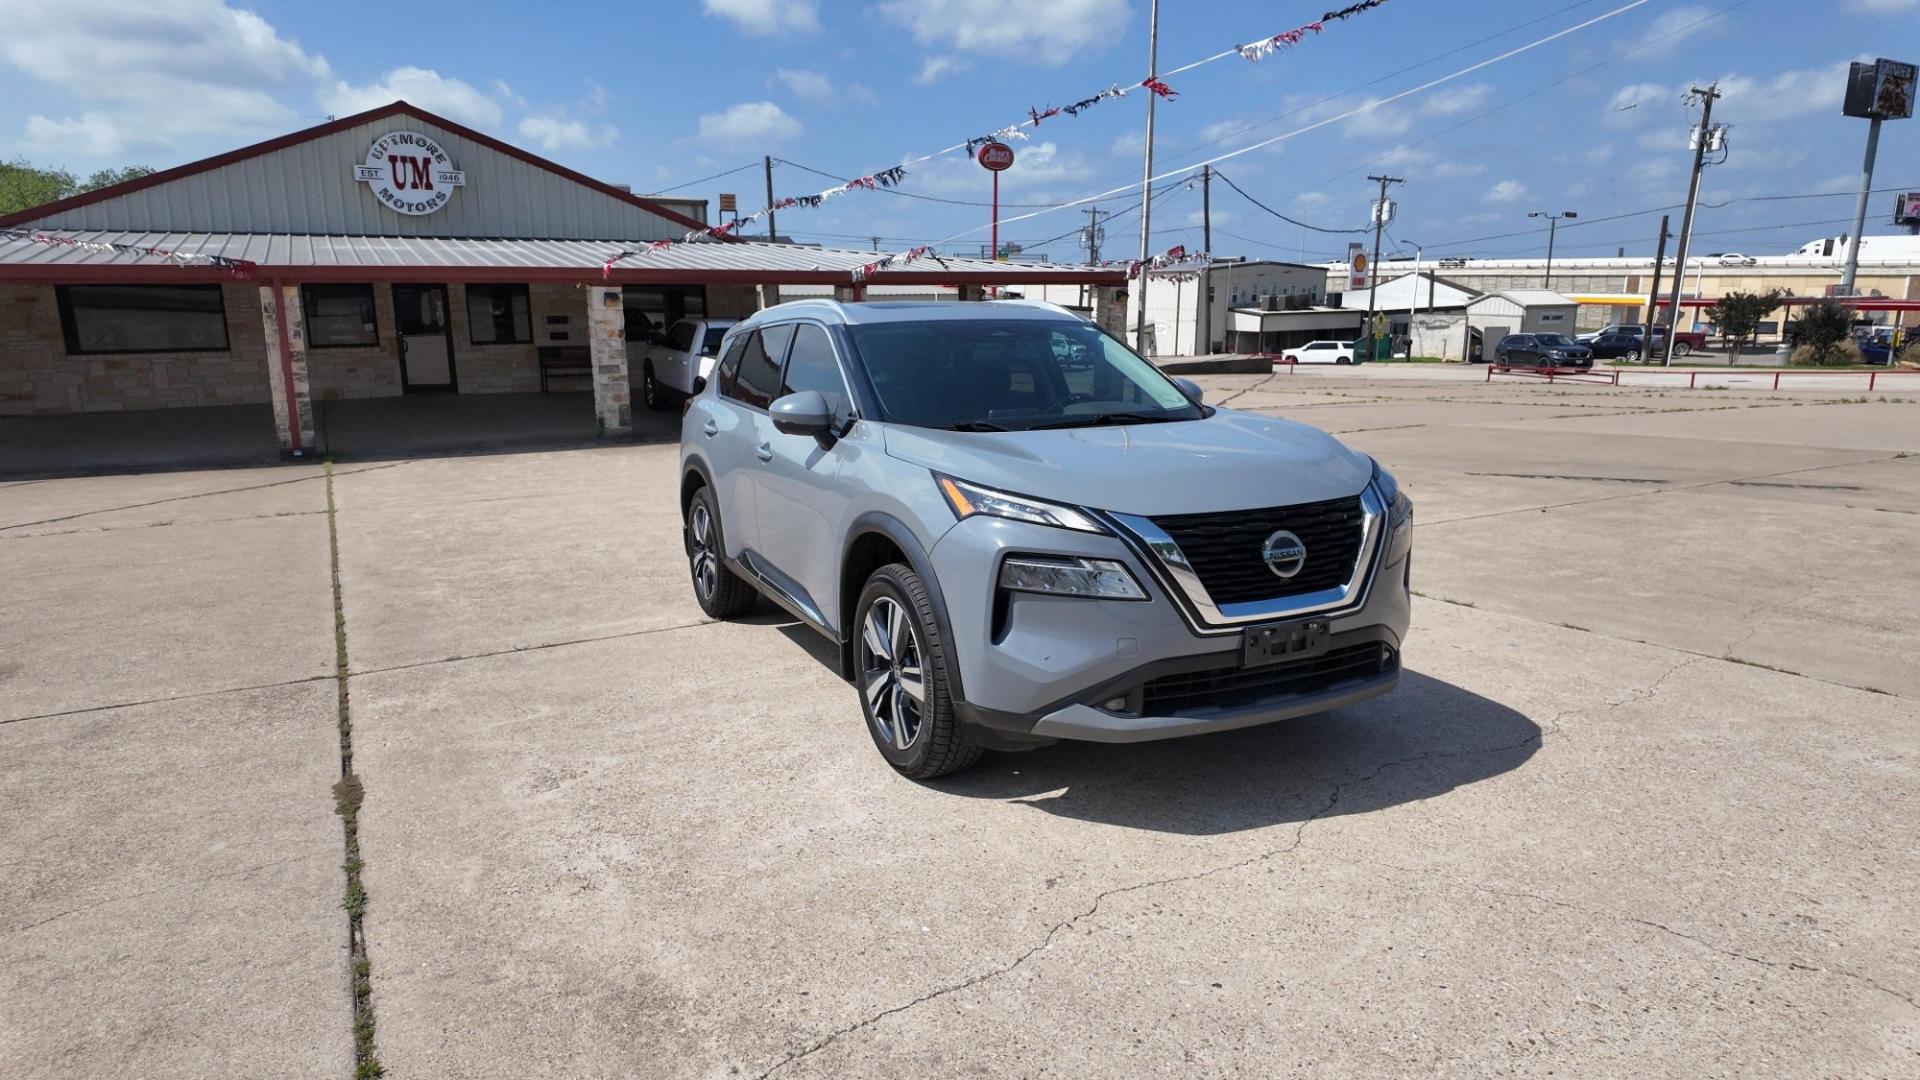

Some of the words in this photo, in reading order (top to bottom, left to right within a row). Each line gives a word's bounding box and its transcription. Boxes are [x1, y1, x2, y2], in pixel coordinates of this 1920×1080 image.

[371, 134, 447, 164] UPTMORE
[388, 155, 434, 190] UM
[440, 174, 460, 182] 1946
[379, 187, 446, 212] MOTORS
[1269, 550, 1303, 560] NISSAN
